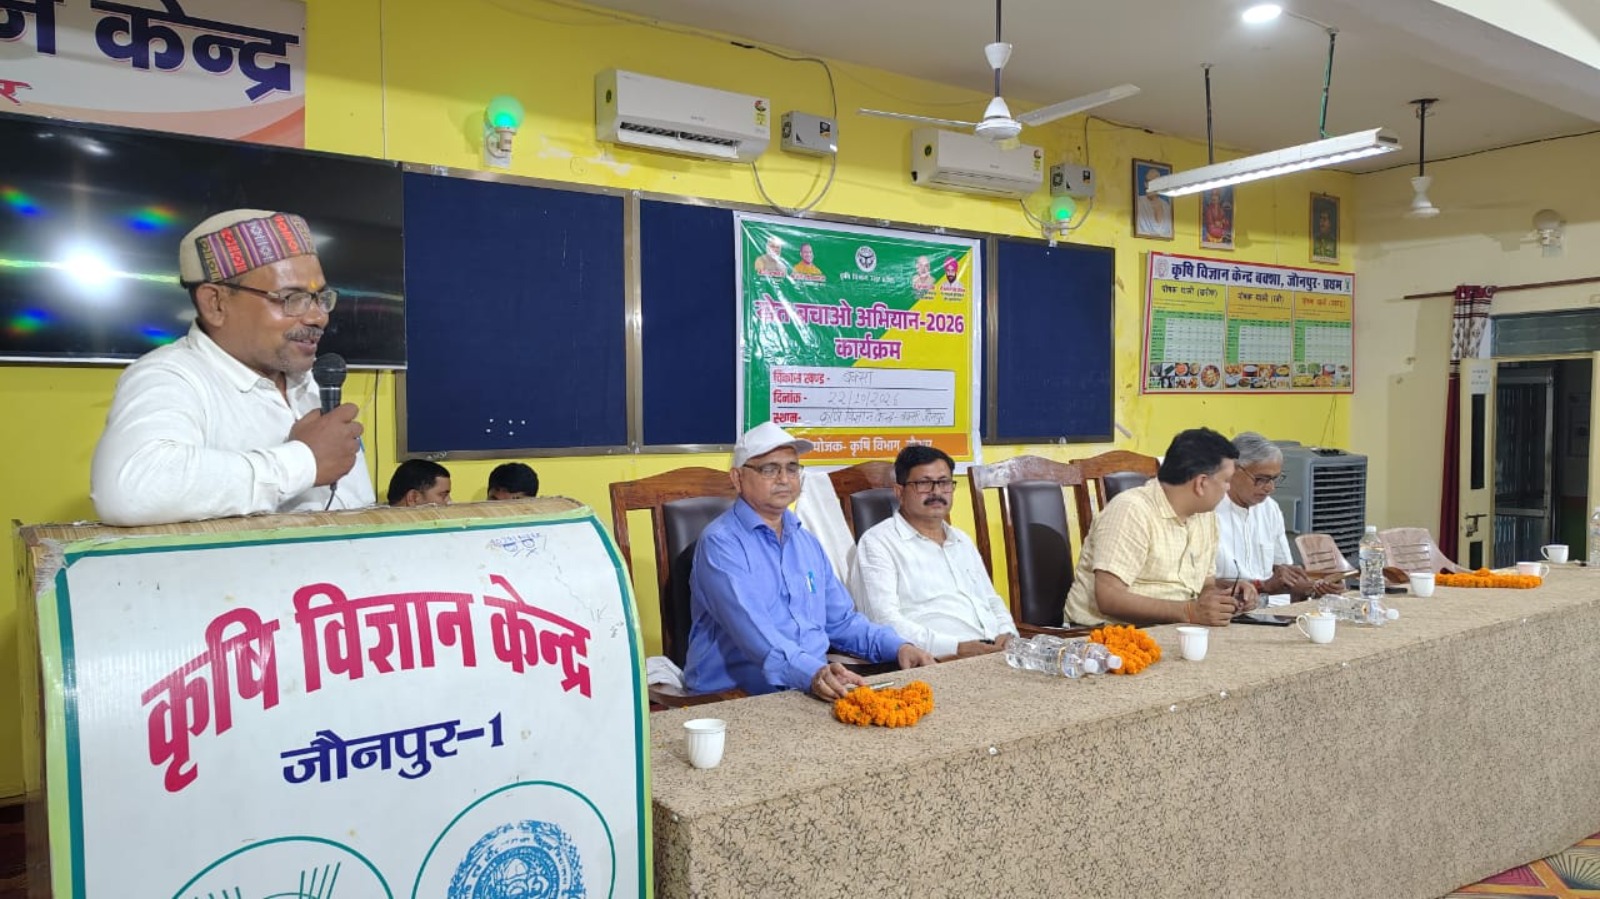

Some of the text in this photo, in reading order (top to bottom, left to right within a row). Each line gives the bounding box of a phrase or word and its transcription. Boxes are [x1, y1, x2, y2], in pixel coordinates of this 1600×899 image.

[1171, 261, 1193, 280] कृषि
[1196, 262, 1229, 281] विज्ञान
[1231, 267, 1252, 284] केन्द्र
[857, 303, 965, 333] अभियान-2026
[835, 334, 902, 361] कार्यक्रम
[773, 371, 801, 384] विकास
[850, 437, 870, 457] कृषि
[142, 575, 592, 793] कृषि विज्ञान केन्द्र
[281, 711, 504, 784] जौनपुर-1
